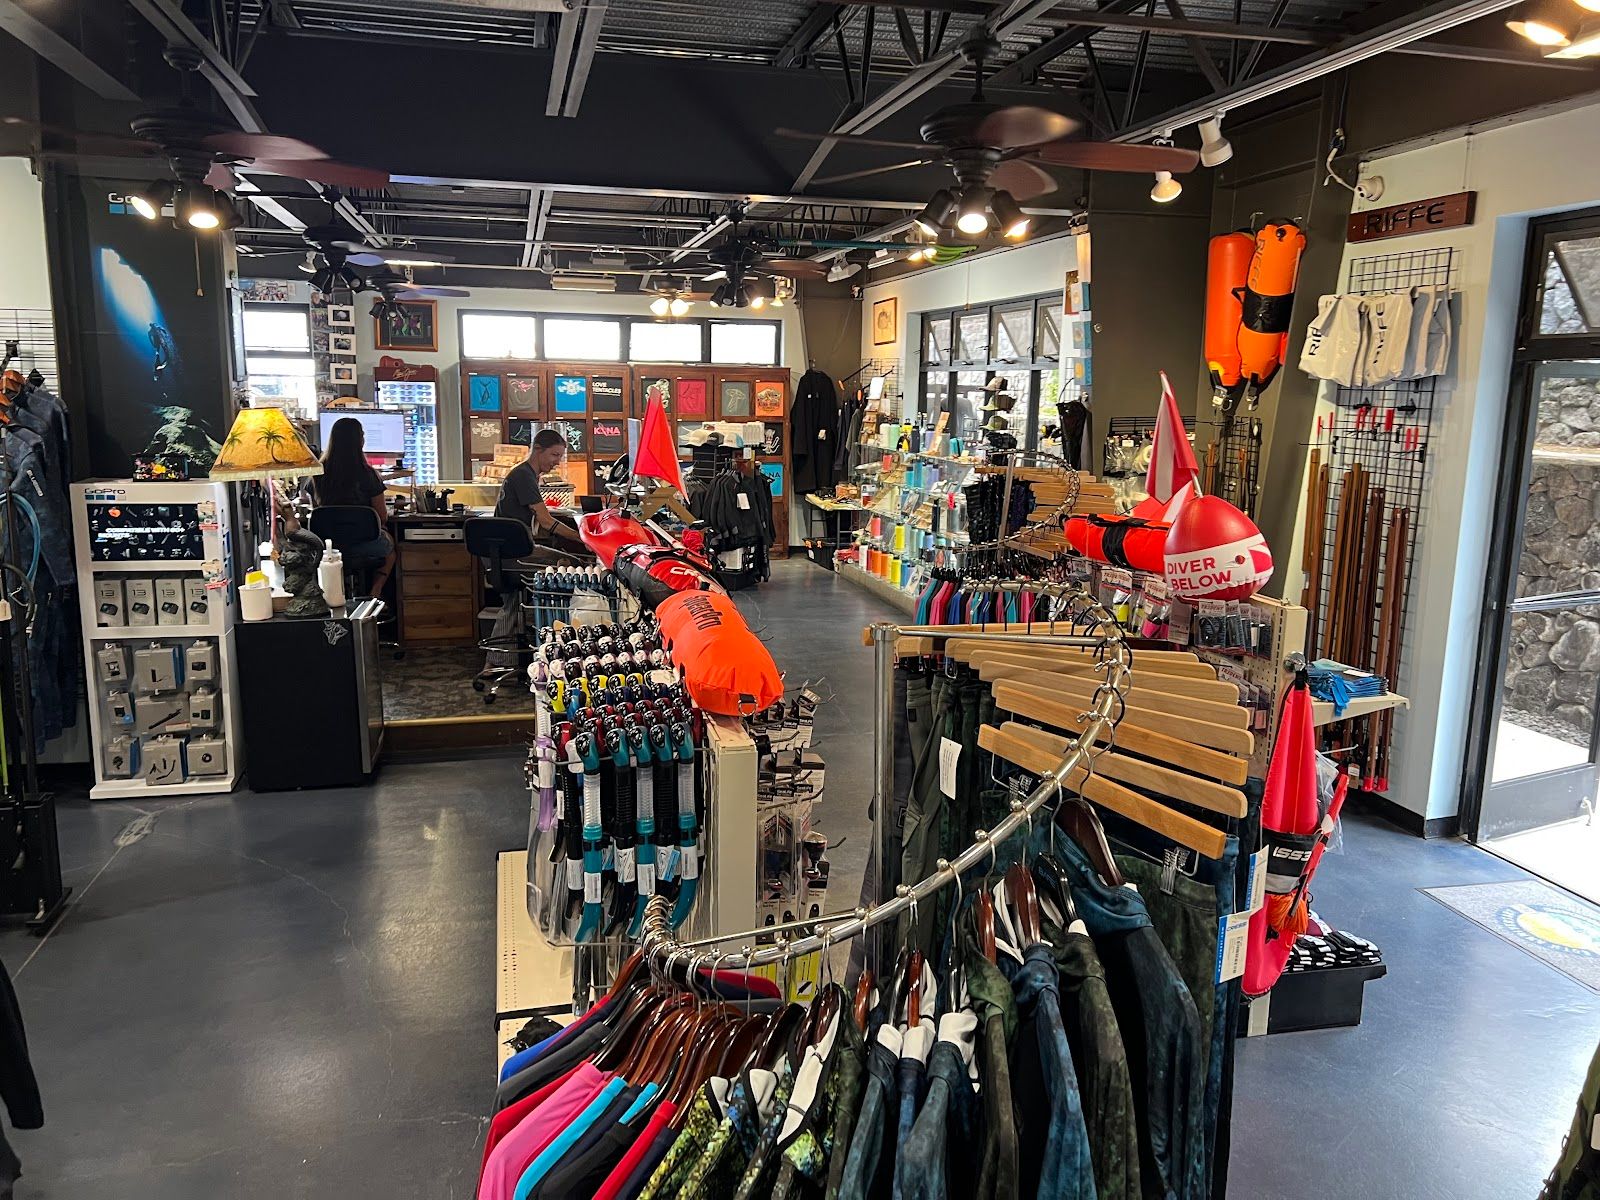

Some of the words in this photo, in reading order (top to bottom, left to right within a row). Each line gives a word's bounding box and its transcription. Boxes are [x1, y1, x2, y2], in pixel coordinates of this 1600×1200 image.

[1364, 202, 1446, 234] RIFFE
[592, 387, 622, 395] TENTACLES
[1167, 557, 1216, 575] DIVER
[1171, 570, 1231, 590] BELOW
[100, 589, 115, 597] 13
[161, 588, 175, 596] 13
[190, 588, 204, 596] 13
[1201, 603, 1224, 611] TRIDENT
[1273, 846, 1312, 862] ESSI
